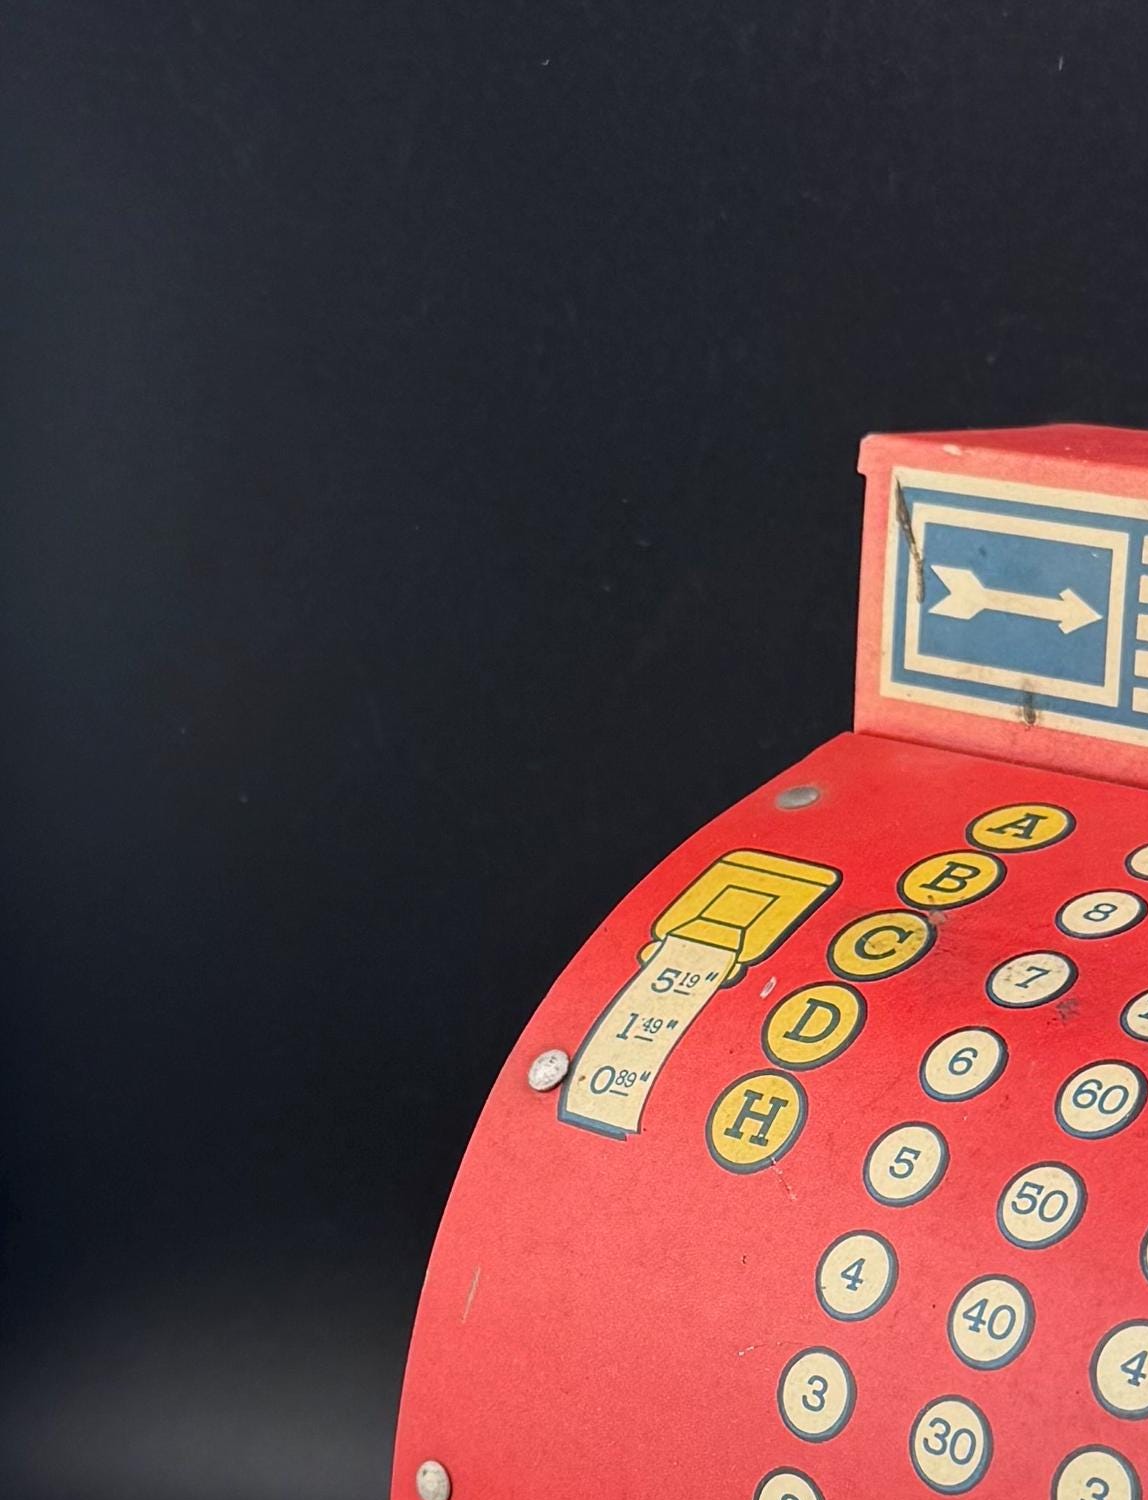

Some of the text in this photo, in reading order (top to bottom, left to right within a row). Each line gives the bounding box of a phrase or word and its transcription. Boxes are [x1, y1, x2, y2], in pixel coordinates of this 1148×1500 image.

[985, 812, 1049, 840] A
[919, 860, 982, 894] B
[1082, 902, 1118, 923] 8
[854, 925, 915, 961] C
[1014, 965, 1052, 989] 7
[782, 997, 842, 1044] D
[948, 1046, 979, 1076] 6
[1072, 1078, 1130, 1115] 60
[723, 1088, 790, 1147] H
[888, 1146, 922, 1180] 5
[1011, 1180, 1069, 1223] 50
[840, 1257, 866, 1292] 4
[962, 1297, 1017, 1341] 40
[1120, 1350, 1148, 1387] 4
[801, 1374, 829, 1413] 3
[922, 1417, 977, 1466] 30
